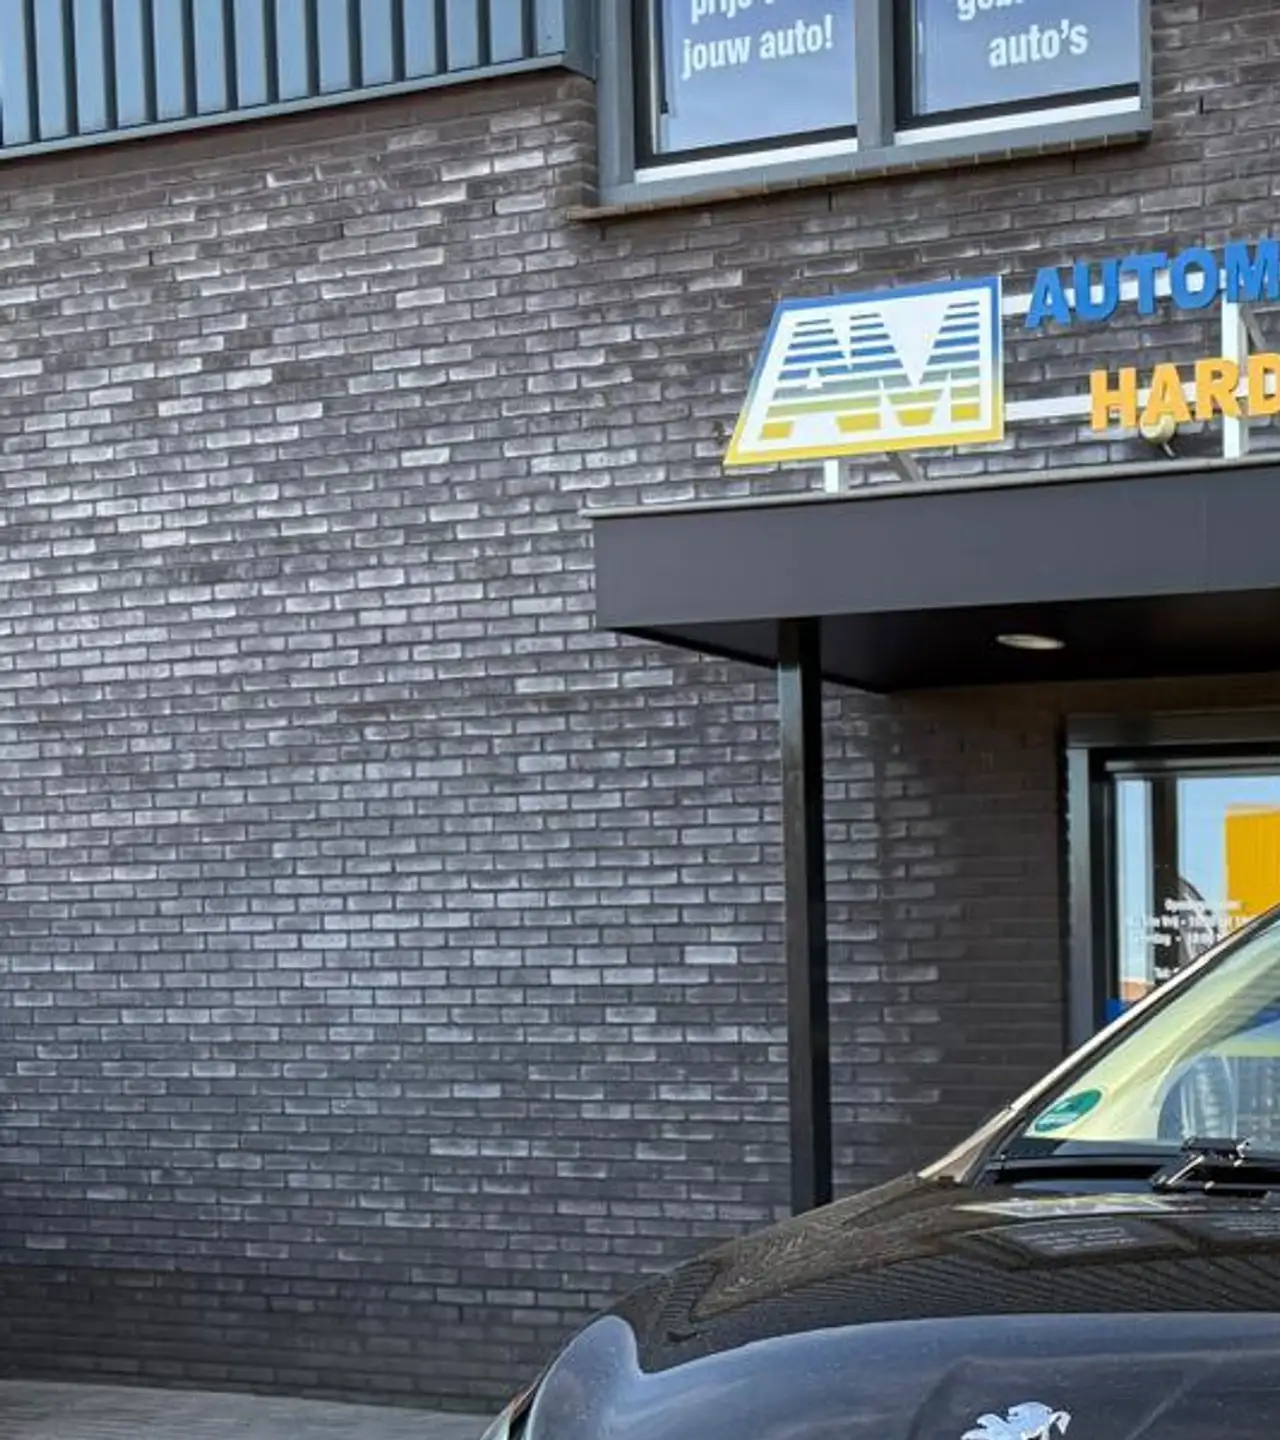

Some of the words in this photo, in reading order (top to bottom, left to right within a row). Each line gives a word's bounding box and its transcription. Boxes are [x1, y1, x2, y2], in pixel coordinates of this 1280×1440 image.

[682, 37, 751, 81] jouw
[759, 13, 834, 60] auto!
[758, 300, 984, 441] AM
